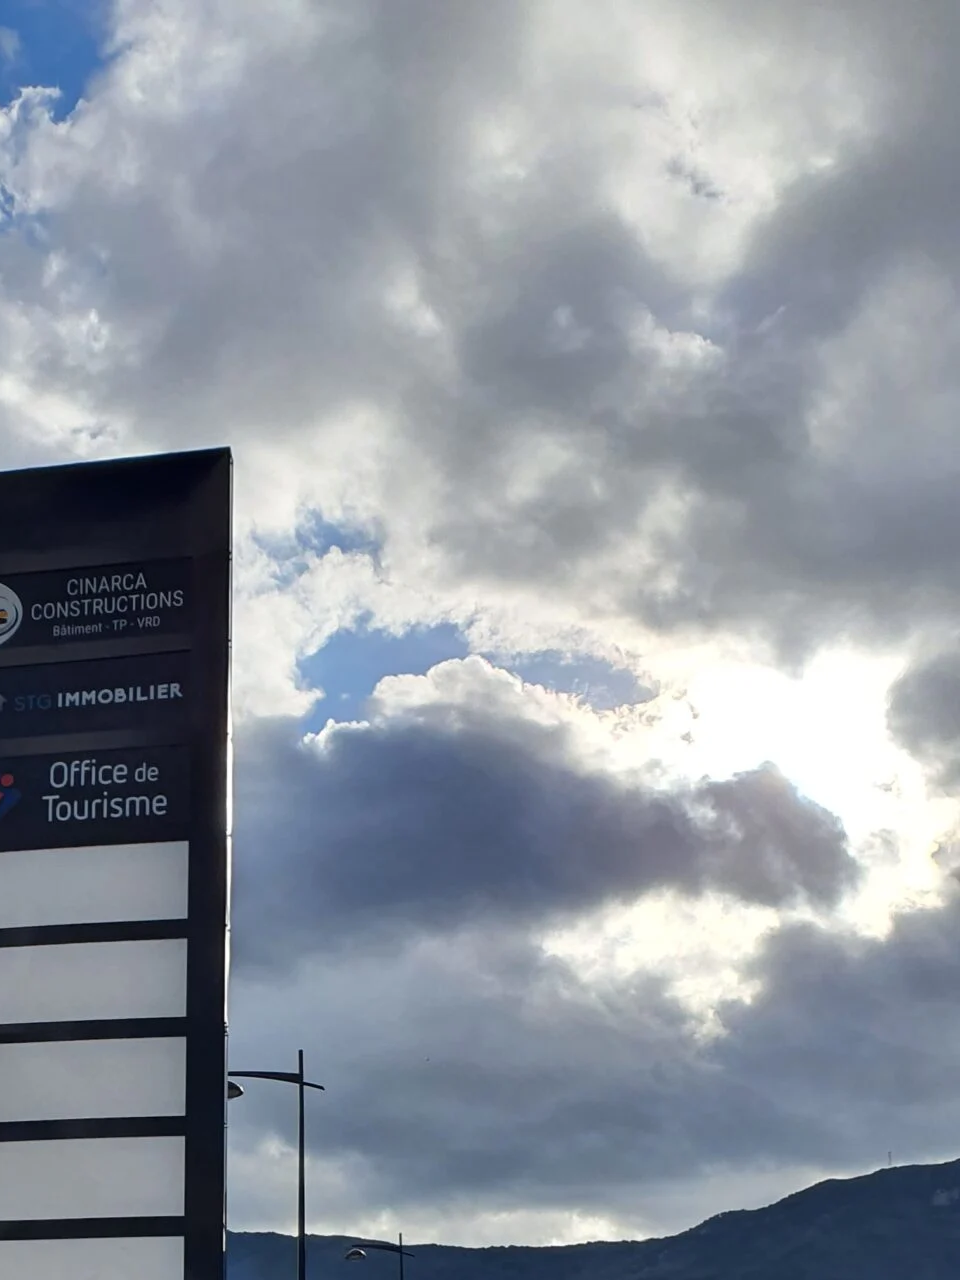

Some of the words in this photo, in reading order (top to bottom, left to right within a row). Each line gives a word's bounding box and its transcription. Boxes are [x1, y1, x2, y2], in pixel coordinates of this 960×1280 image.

[66, 573, 147, 596] CINARCA
[31, 590, 184, 621] CONSTRUCTIONS
[52, 622, 102, 637] Bâtiment
[112, 620, 128, 631] TP
[137, 616, 161, 628] VRD
[14, 695, 51, 712] STG
[57, 683, 183, 708] IMMOBILIER
[50, 759, 128, 788] Office
[135, 762, 159, 782] de
[42, 791, 168, 822] Tourisme
